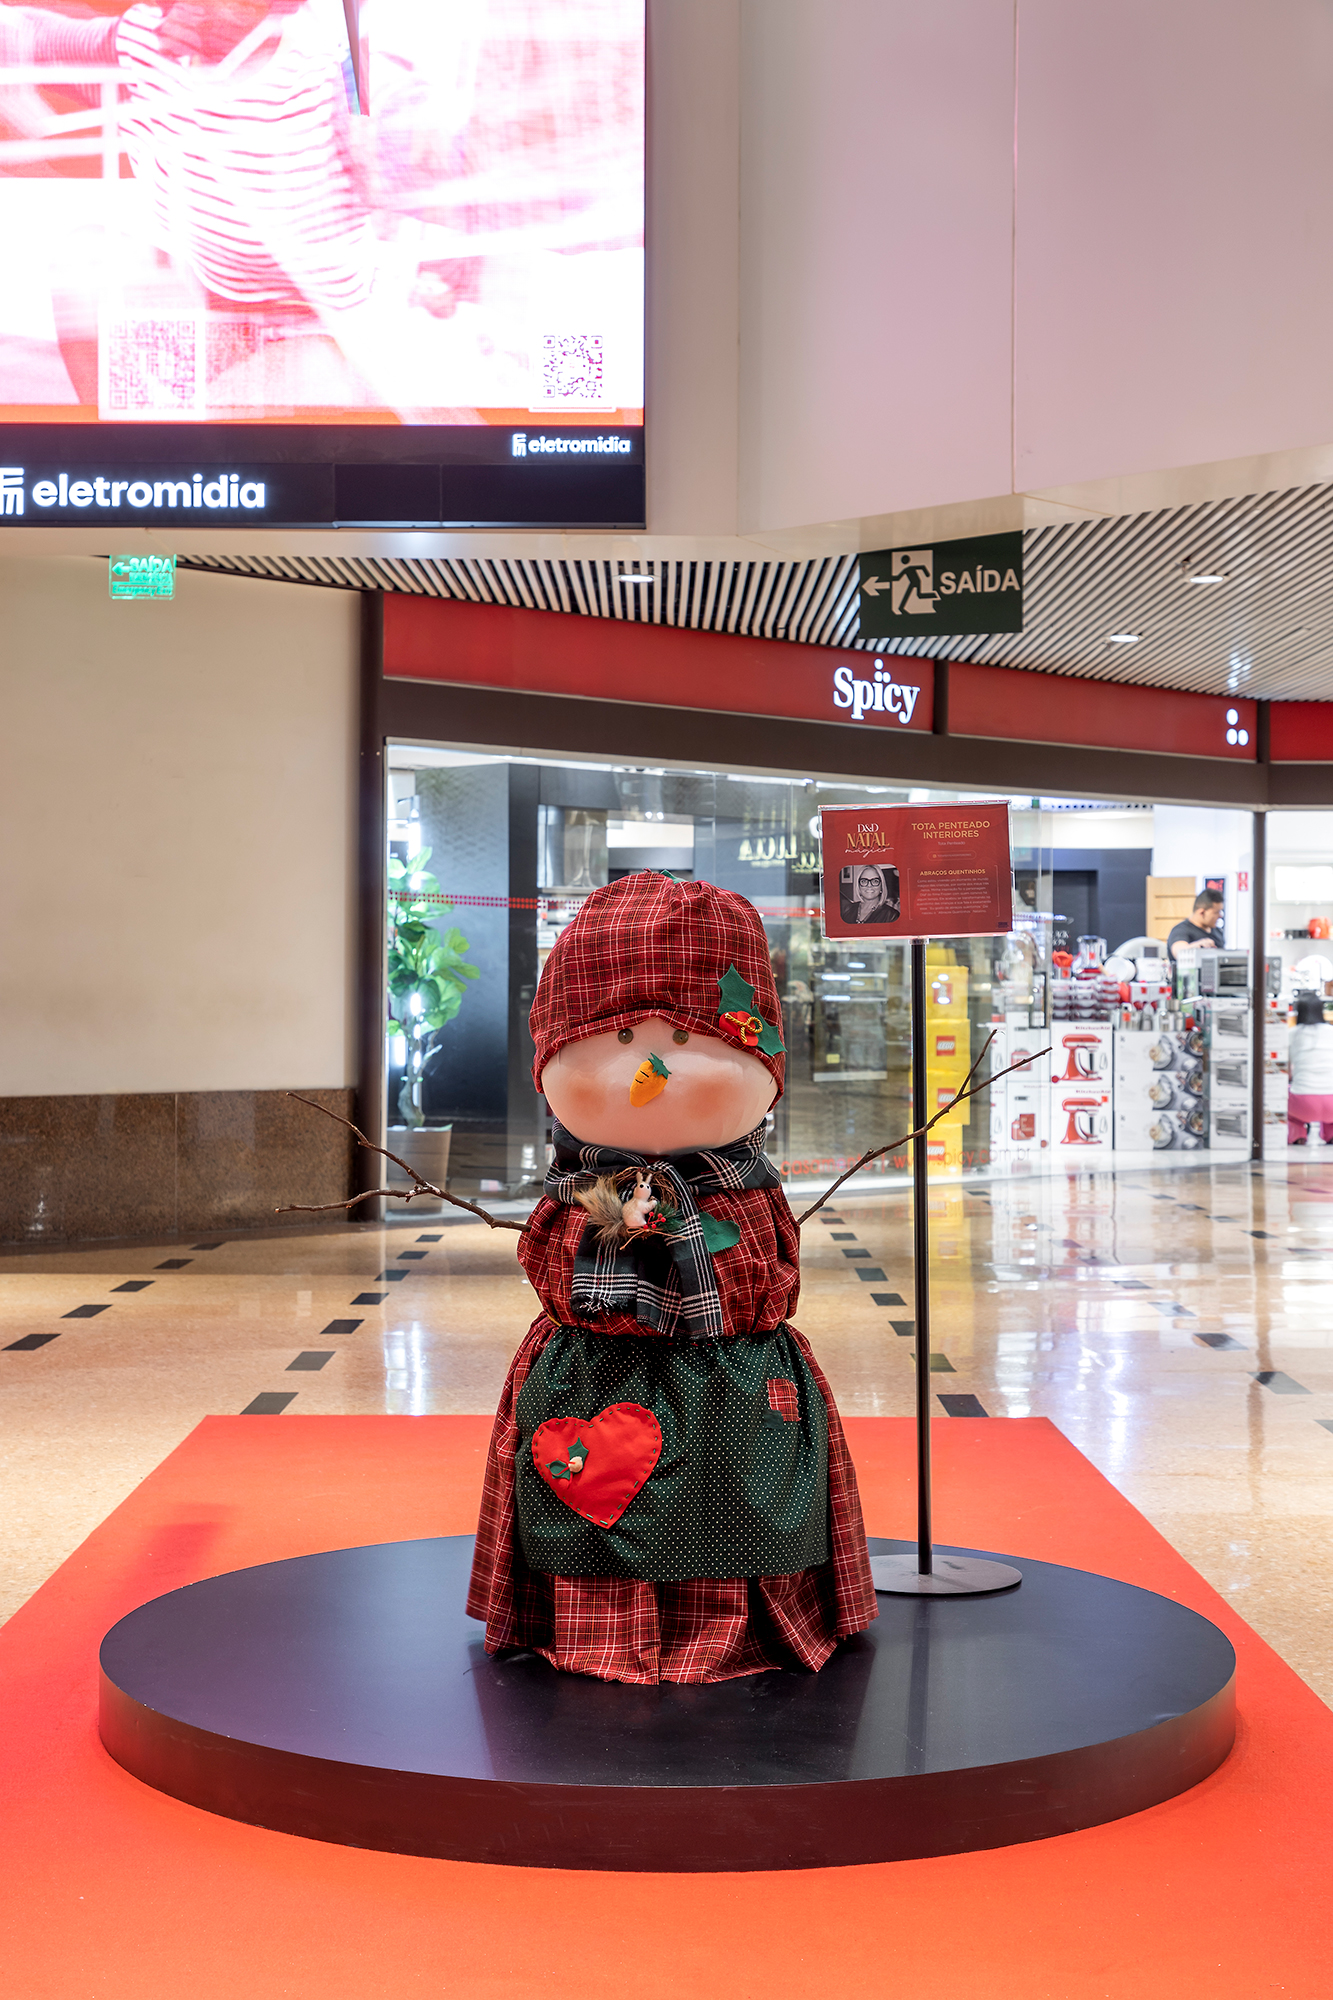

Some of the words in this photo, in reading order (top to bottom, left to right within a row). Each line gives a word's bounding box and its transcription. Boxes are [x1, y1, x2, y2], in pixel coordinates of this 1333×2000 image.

[528, 436, 631, 453] eletromidia
[32, 473, 266, 508] eletromidia
[129, 555, 174, 573] SAÍDA
[940, 564, 1021, 595] SAÍDA
[833, 658, 921, 724] Spicy
[857, 823, 879, 833] D&D
[911, 822, 936, 831] TOTA
[938, 820, 990, 830] PENTEADO
[923, 829, 980, 839] INTERIORES
[847, 832, 890, 849] NATAL
